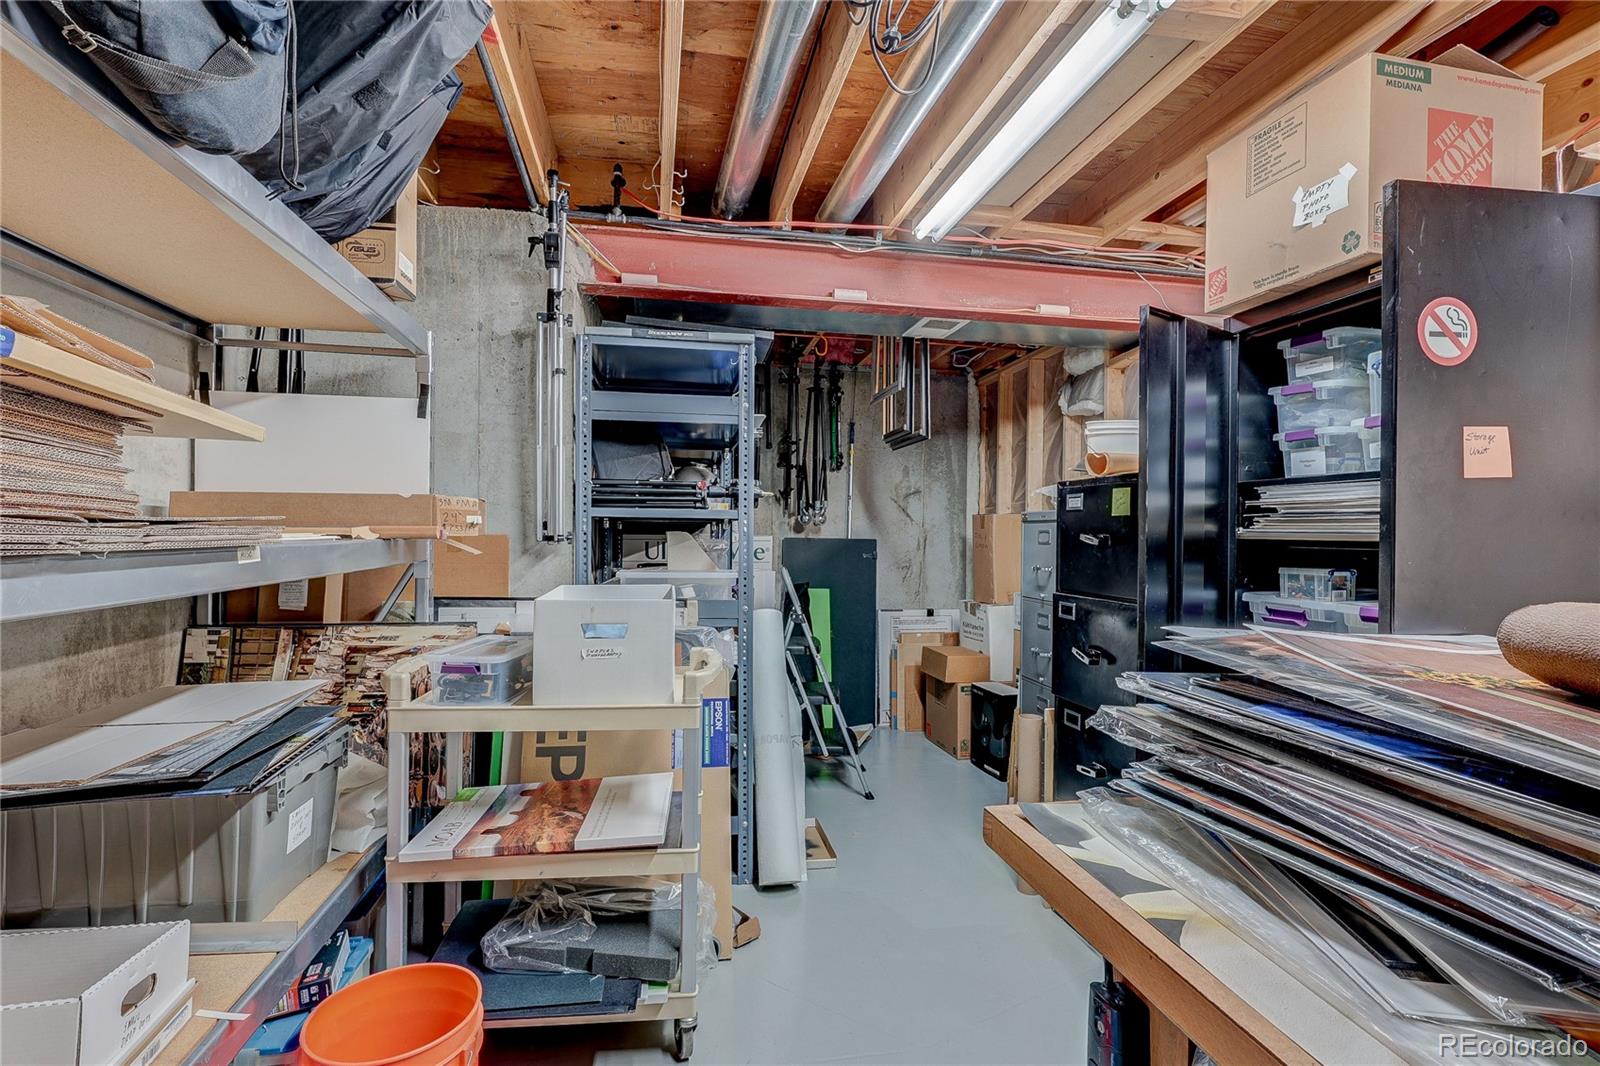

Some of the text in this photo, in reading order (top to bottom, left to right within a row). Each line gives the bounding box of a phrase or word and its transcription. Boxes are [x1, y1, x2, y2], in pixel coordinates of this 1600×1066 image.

[1384, 63, 1424, 80] MEDIUM
[1386, 79, 1423, 93] MEDIANA
[1457, 74, 1541, 95] www.homedepotmoving.com
[1253, 120, 1282, 142] FRAGILE
[1433, 121, 1462, 151] THE
[1426, 116, 1494, 183] HOME
[1301, 179, 1335, 203] EMPTY
[1303, 204, 1331, 222] BOXES
[349, 245, 377, 254] ASUS
[714, 701, 724, 730] EPSON
[425, 820, 464, 848] MOAB
